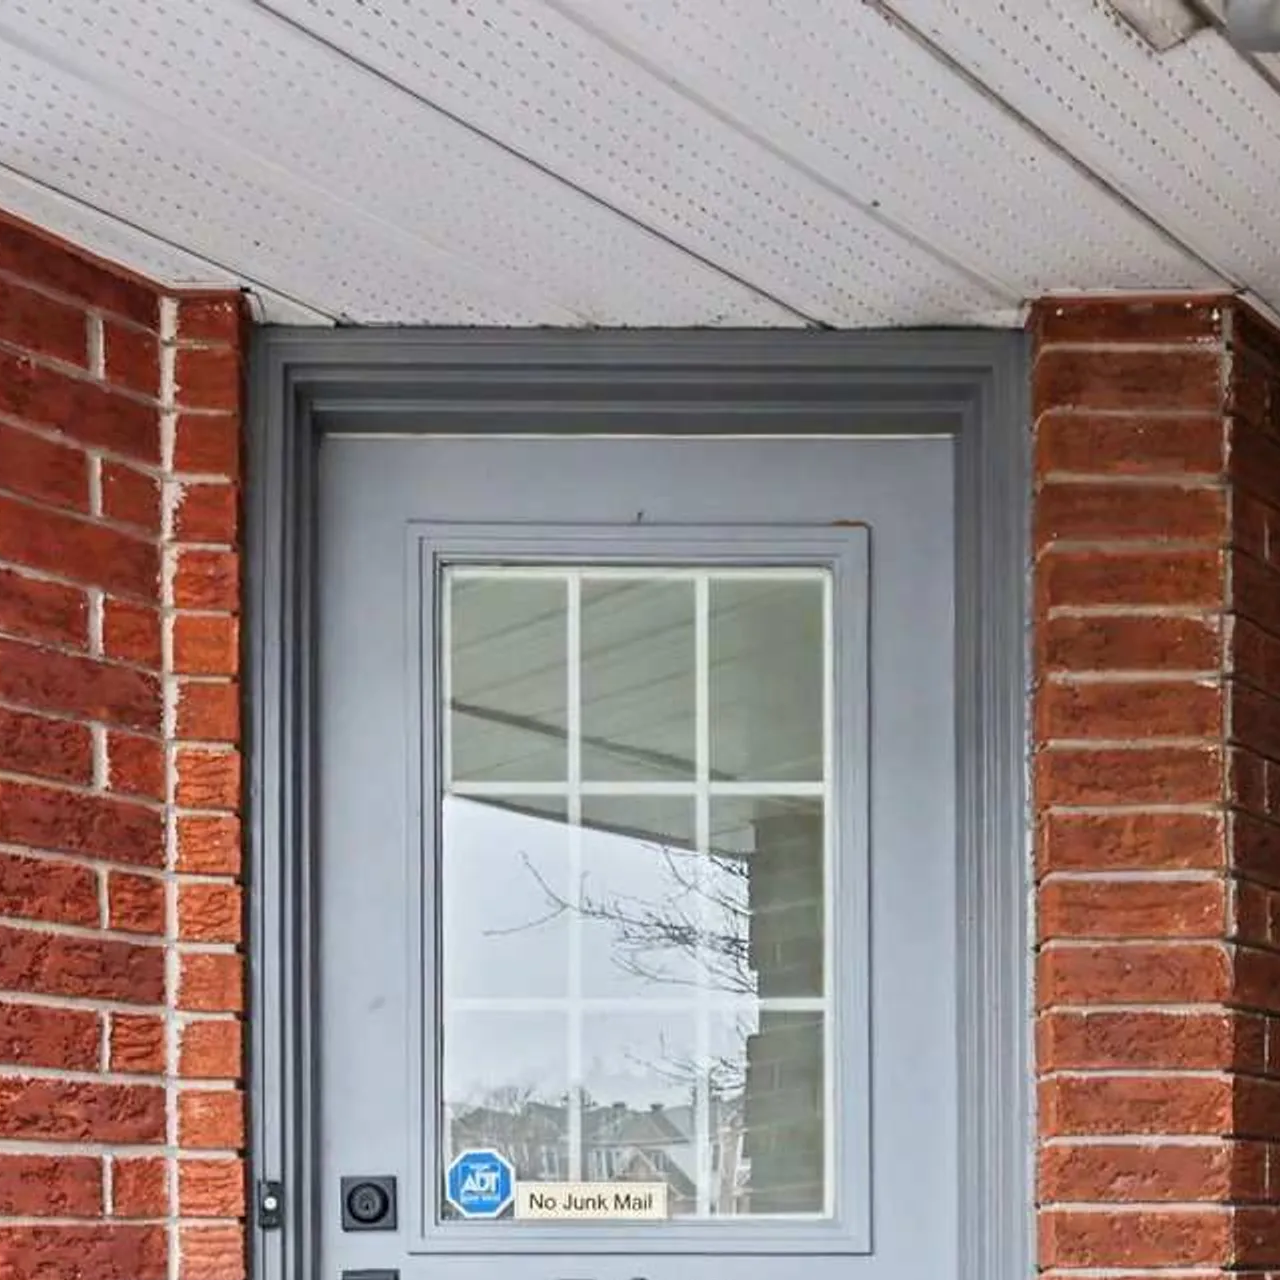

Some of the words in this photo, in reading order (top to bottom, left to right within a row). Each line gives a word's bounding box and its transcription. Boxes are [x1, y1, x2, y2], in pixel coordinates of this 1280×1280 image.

[462, 1171, 499, 1191] ADT
[529, 1193, 557, 1211] No
[562, 1193, 609, 1211] Junk
[614, 1193, 653, 1211] Mail
